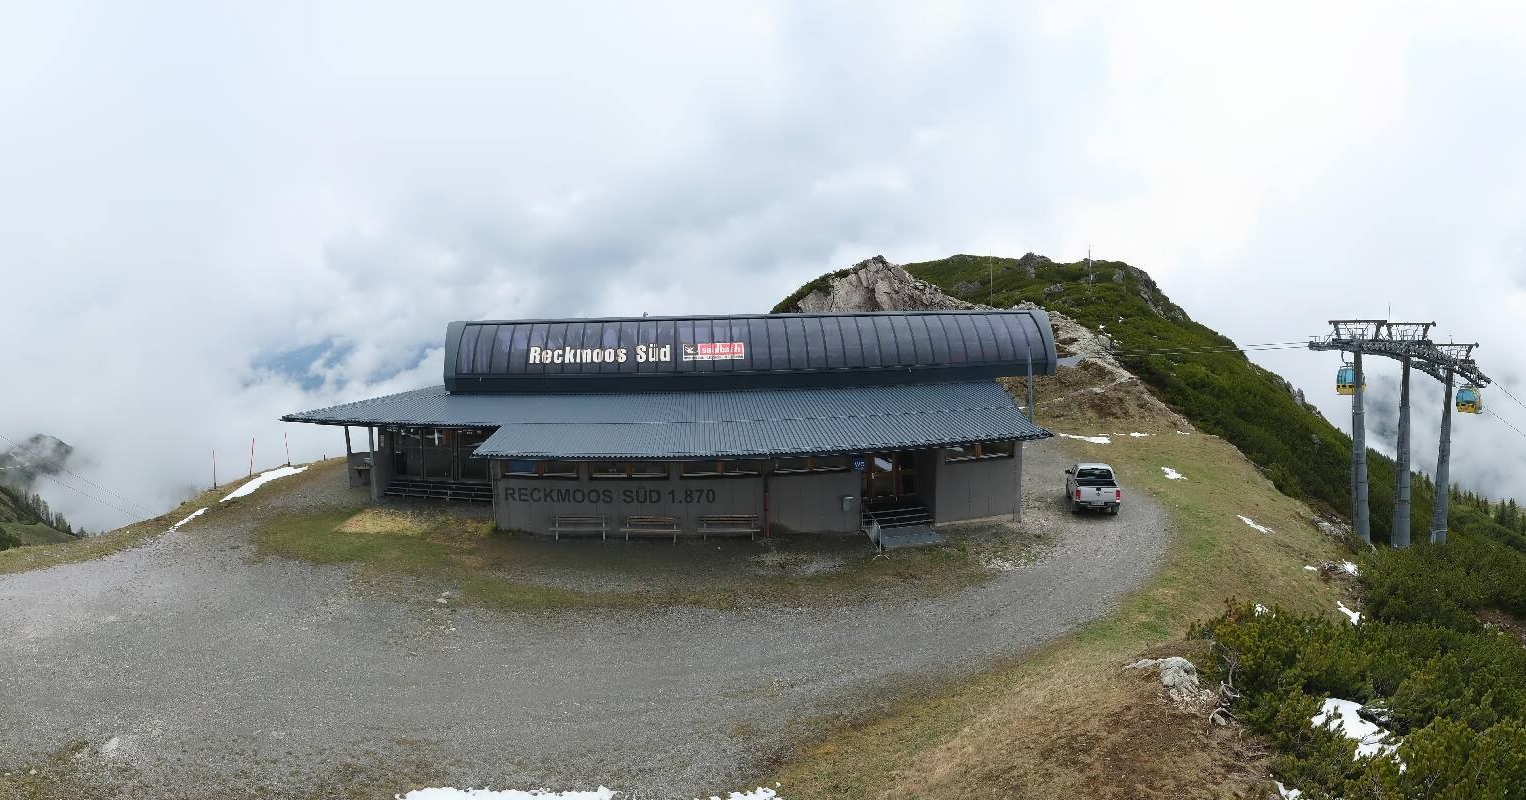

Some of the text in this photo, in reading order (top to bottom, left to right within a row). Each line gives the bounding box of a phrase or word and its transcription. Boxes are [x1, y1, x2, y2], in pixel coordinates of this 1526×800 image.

[529, 344, 671, 363] Reckmoos Süd
[504, 486, 716, 504] RECKMOOS SÜD 1.870
